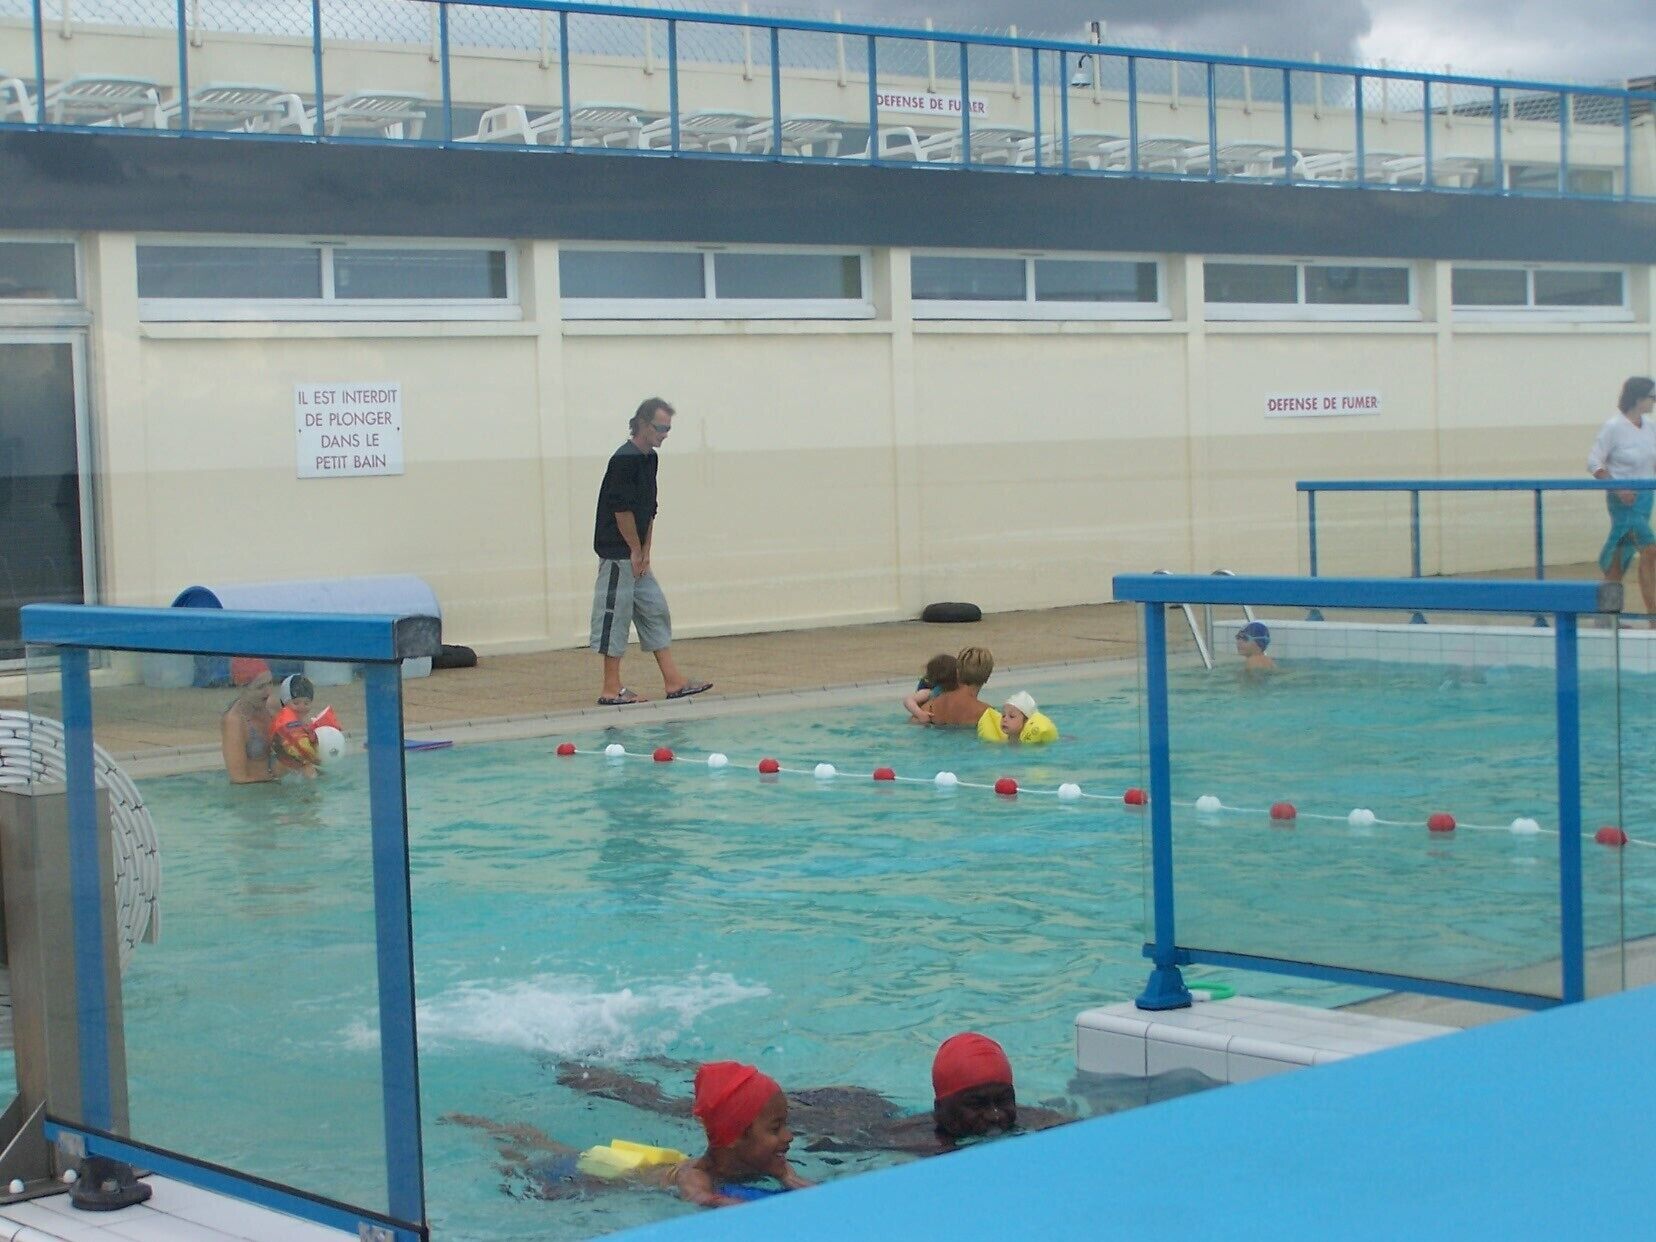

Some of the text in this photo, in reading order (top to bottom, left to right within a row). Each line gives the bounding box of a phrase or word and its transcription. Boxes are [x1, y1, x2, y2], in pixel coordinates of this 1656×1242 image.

[876, 94, 985, 113] DEFENSE DE FUER
[298, 389, 398, 405] IL EST INTERDIT
[1268, 396, 1378, 411] DEFENSE DE FUMER
[305, 411, 392, 427] DE PLONGER
[321, 433, 379, 448] DANS LE
[316, 454, 386, 470] PETIT BAIN
